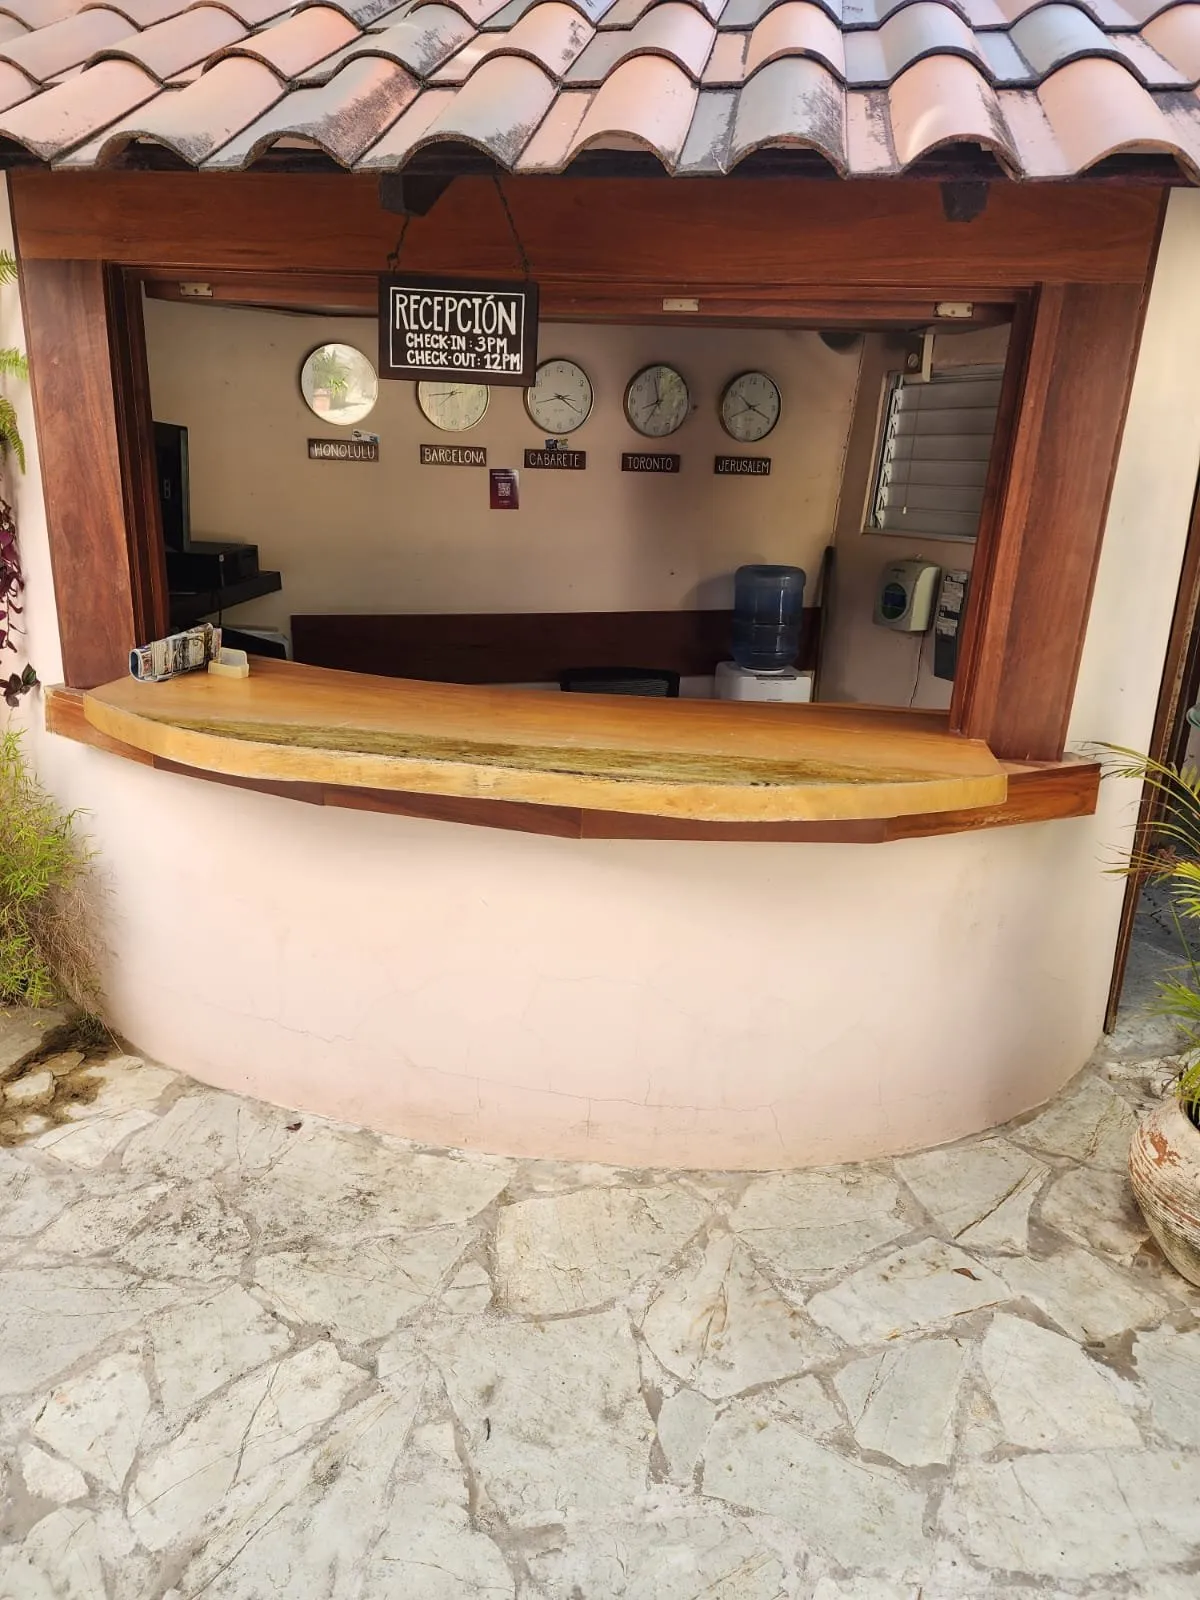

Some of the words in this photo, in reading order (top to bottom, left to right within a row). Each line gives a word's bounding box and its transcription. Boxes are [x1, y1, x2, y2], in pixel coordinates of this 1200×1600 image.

[395, 293, 516, 335] RECEPCIÓN
[474, 335, 508, 354] 3PM
[484, 353, 521, 371] 12PM
[313, 443, 375, 460] HONOLULU
[424, 449, 486, 464] BARCELONA
[529, 452, 580, 467] CABARETE
[627, 456, 673, 471] TORONTO
[718, 458, 770, 474] JERUSALEM
